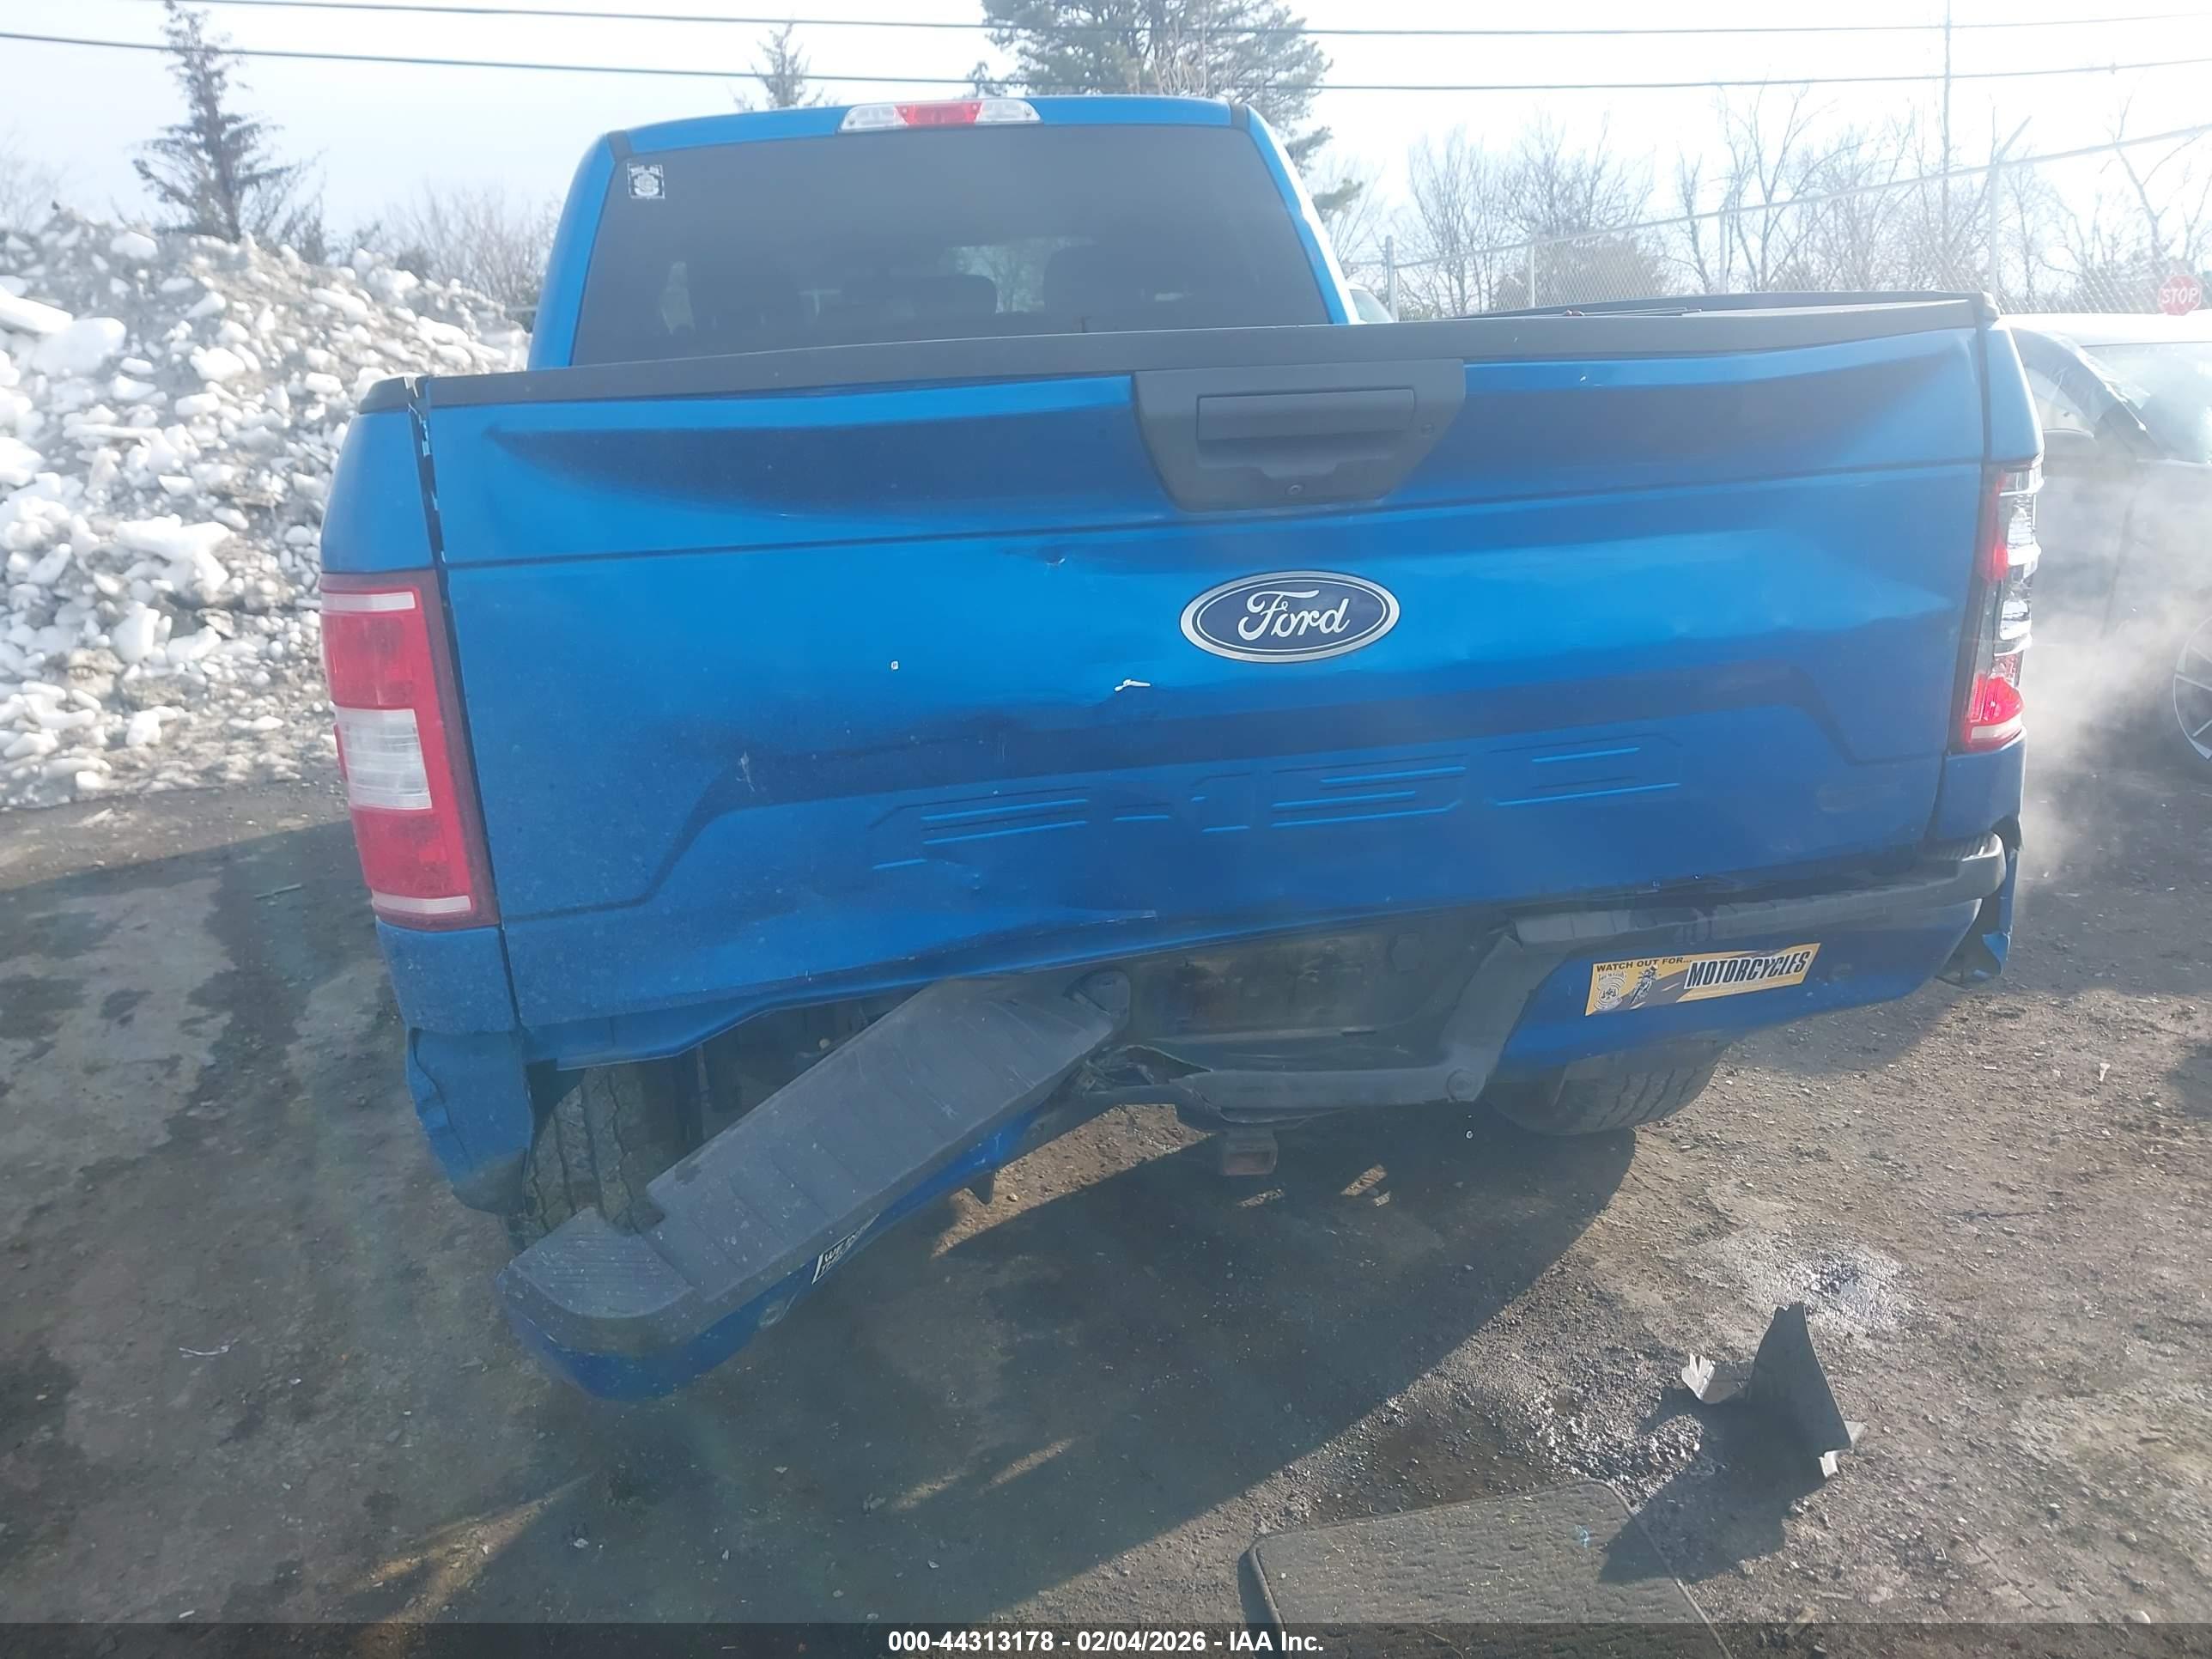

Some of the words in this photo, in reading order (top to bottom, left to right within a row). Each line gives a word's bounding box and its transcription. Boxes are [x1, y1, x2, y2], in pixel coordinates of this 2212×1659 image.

[2161, 288, 2198, 303] STOP
[1237, 589, 1351, 641] Ford
[1596, 962, 1633, 972] WATCH
[1637, 959, 1658, 969] OUT
[1686, 951, 1810, 988] MOTORCYCLES
